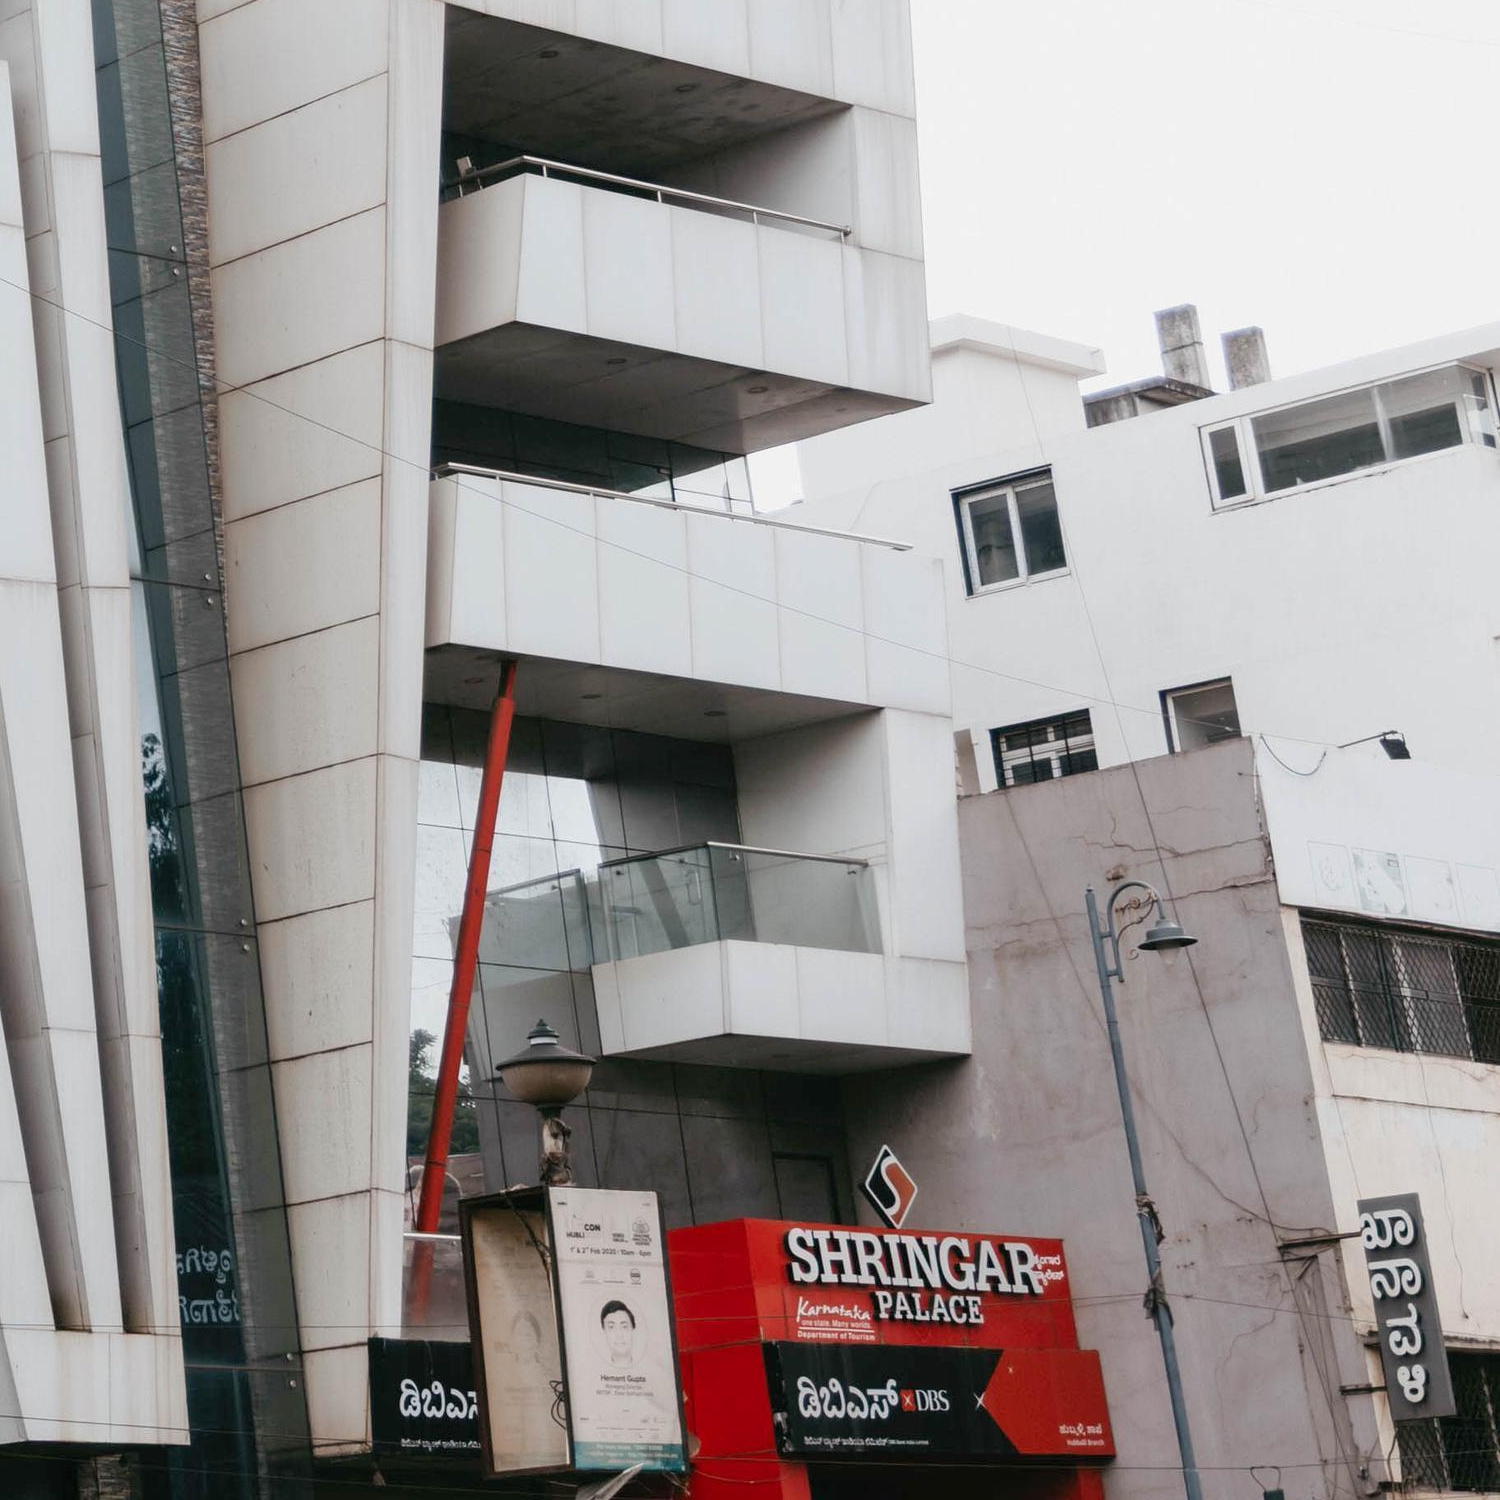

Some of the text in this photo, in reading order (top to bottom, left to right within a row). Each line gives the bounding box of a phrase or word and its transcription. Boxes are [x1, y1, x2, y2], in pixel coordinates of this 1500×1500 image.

[787, 1227, 1044, 1295] SHRINGAR
[796, 1296, 870, 1322] Karnataka
[875, 1290, 985, 1324] PALACE
[797, 1330, 875, 1341] Department of Tourism
[797, 1376, 949, 1419] ಡಿಬಿಎಸ್ DBS
